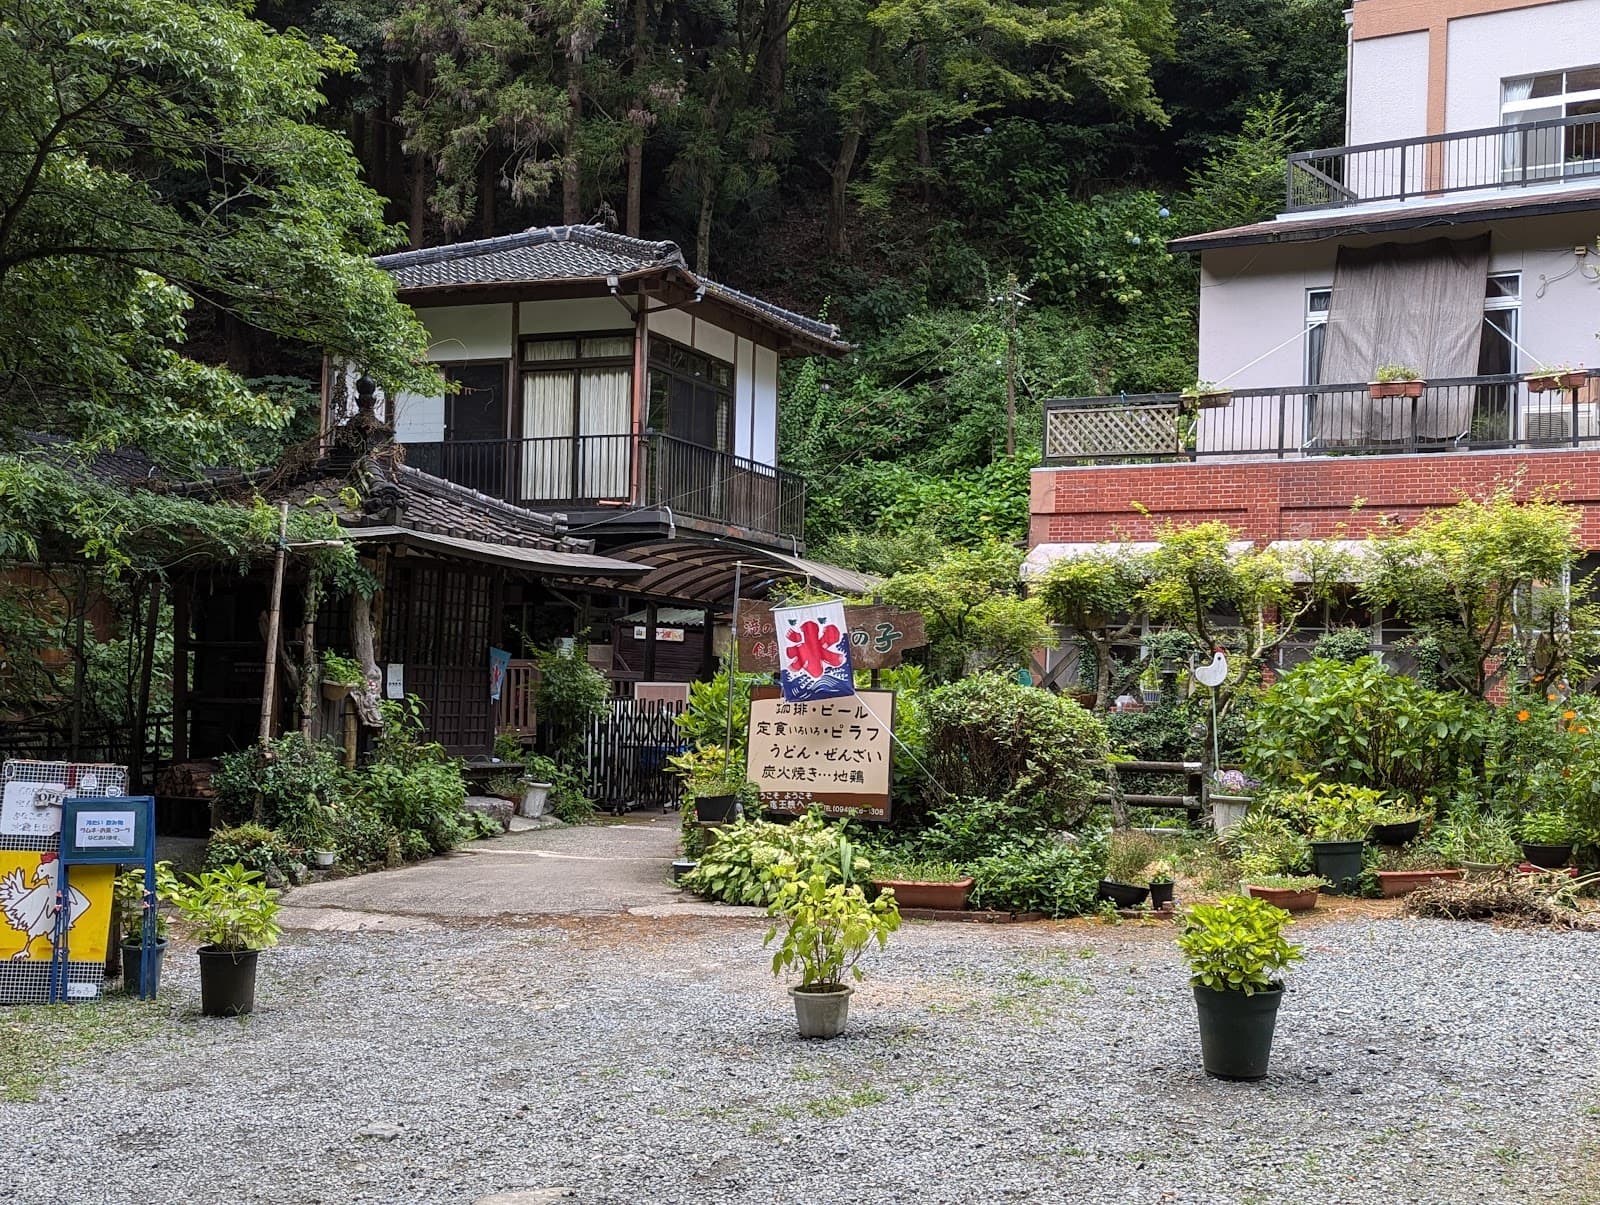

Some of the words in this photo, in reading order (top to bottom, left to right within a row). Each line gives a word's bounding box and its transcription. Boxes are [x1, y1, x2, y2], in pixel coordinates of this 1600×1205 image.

[785, 620, 846, 678] 氷
[776, 702, 869, 719] 珈琲・ビール
[756, 721, 879, 741] 定食いろいろ・ピラフ
[770, 743, 882, 763] うどん・ぜんざい
[784, 792, 813, 800] ようこそ
